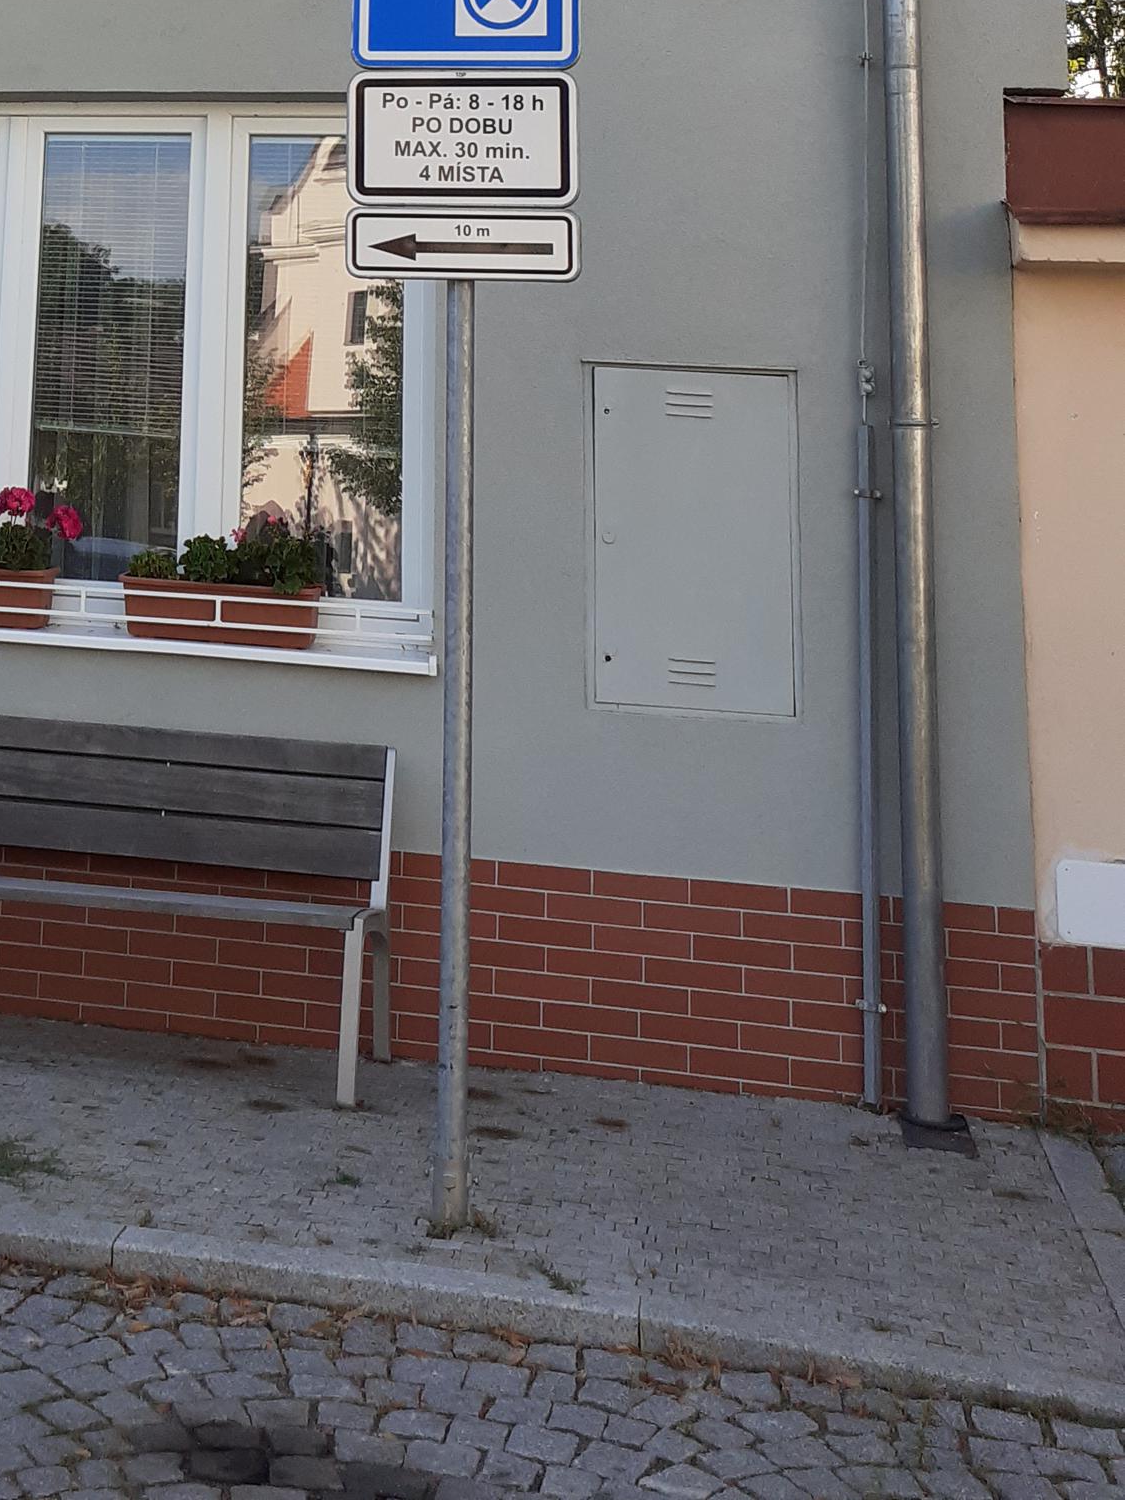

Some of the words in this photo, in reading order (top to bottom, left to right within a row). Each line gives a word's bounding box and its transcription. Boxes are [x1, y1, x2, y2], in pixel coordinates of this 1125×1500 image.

[382, 93, 408, 109] Po
[429, 93, 461, 110] Pá:
[469, 94, 480, 110] 8
[501, 94, 524, 111] 18
[532, 95, 544, 111] h
[412, 117, 442, 133] PO
[449, 117, 513, 134] DOBU
[394, 141, 447, 157] MAX.
[455, 142, 478, 158] 30
[486, 143, 530, 159] min.
[419, 165, 430, 181] 4
[438, 162, 504, 183] MÍSTA
[455, 224, 471, 236] 10
[476, 227, 490, 236] m
